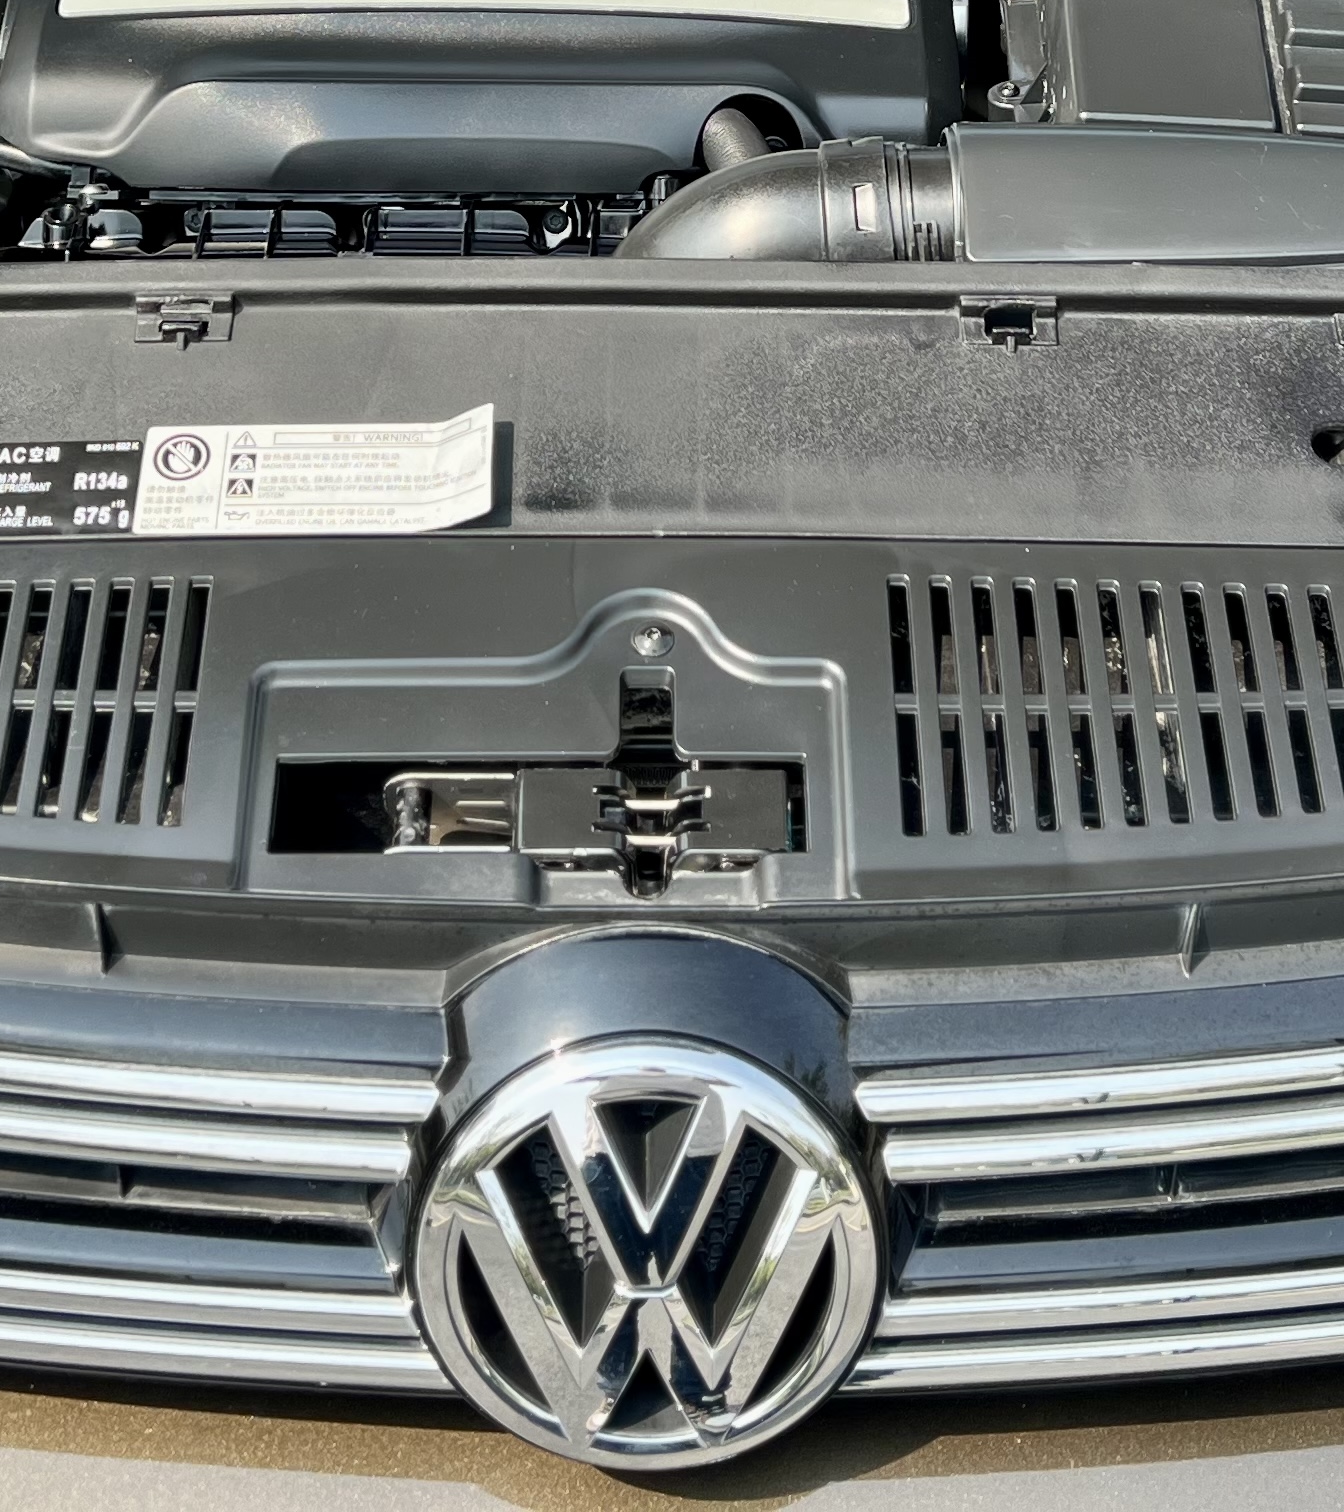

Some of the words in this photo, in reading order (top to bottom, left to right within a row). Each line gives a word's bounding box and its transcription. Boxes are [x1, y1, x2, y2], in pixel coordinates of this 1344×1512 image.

[73, 472, 128, 490] R134a
[27, 516, 54, 527] LEVEL
[73, 505, 110, 525] 575
[117, 510, 130, 528] g
[451, 1071, 846, 1455] VW
